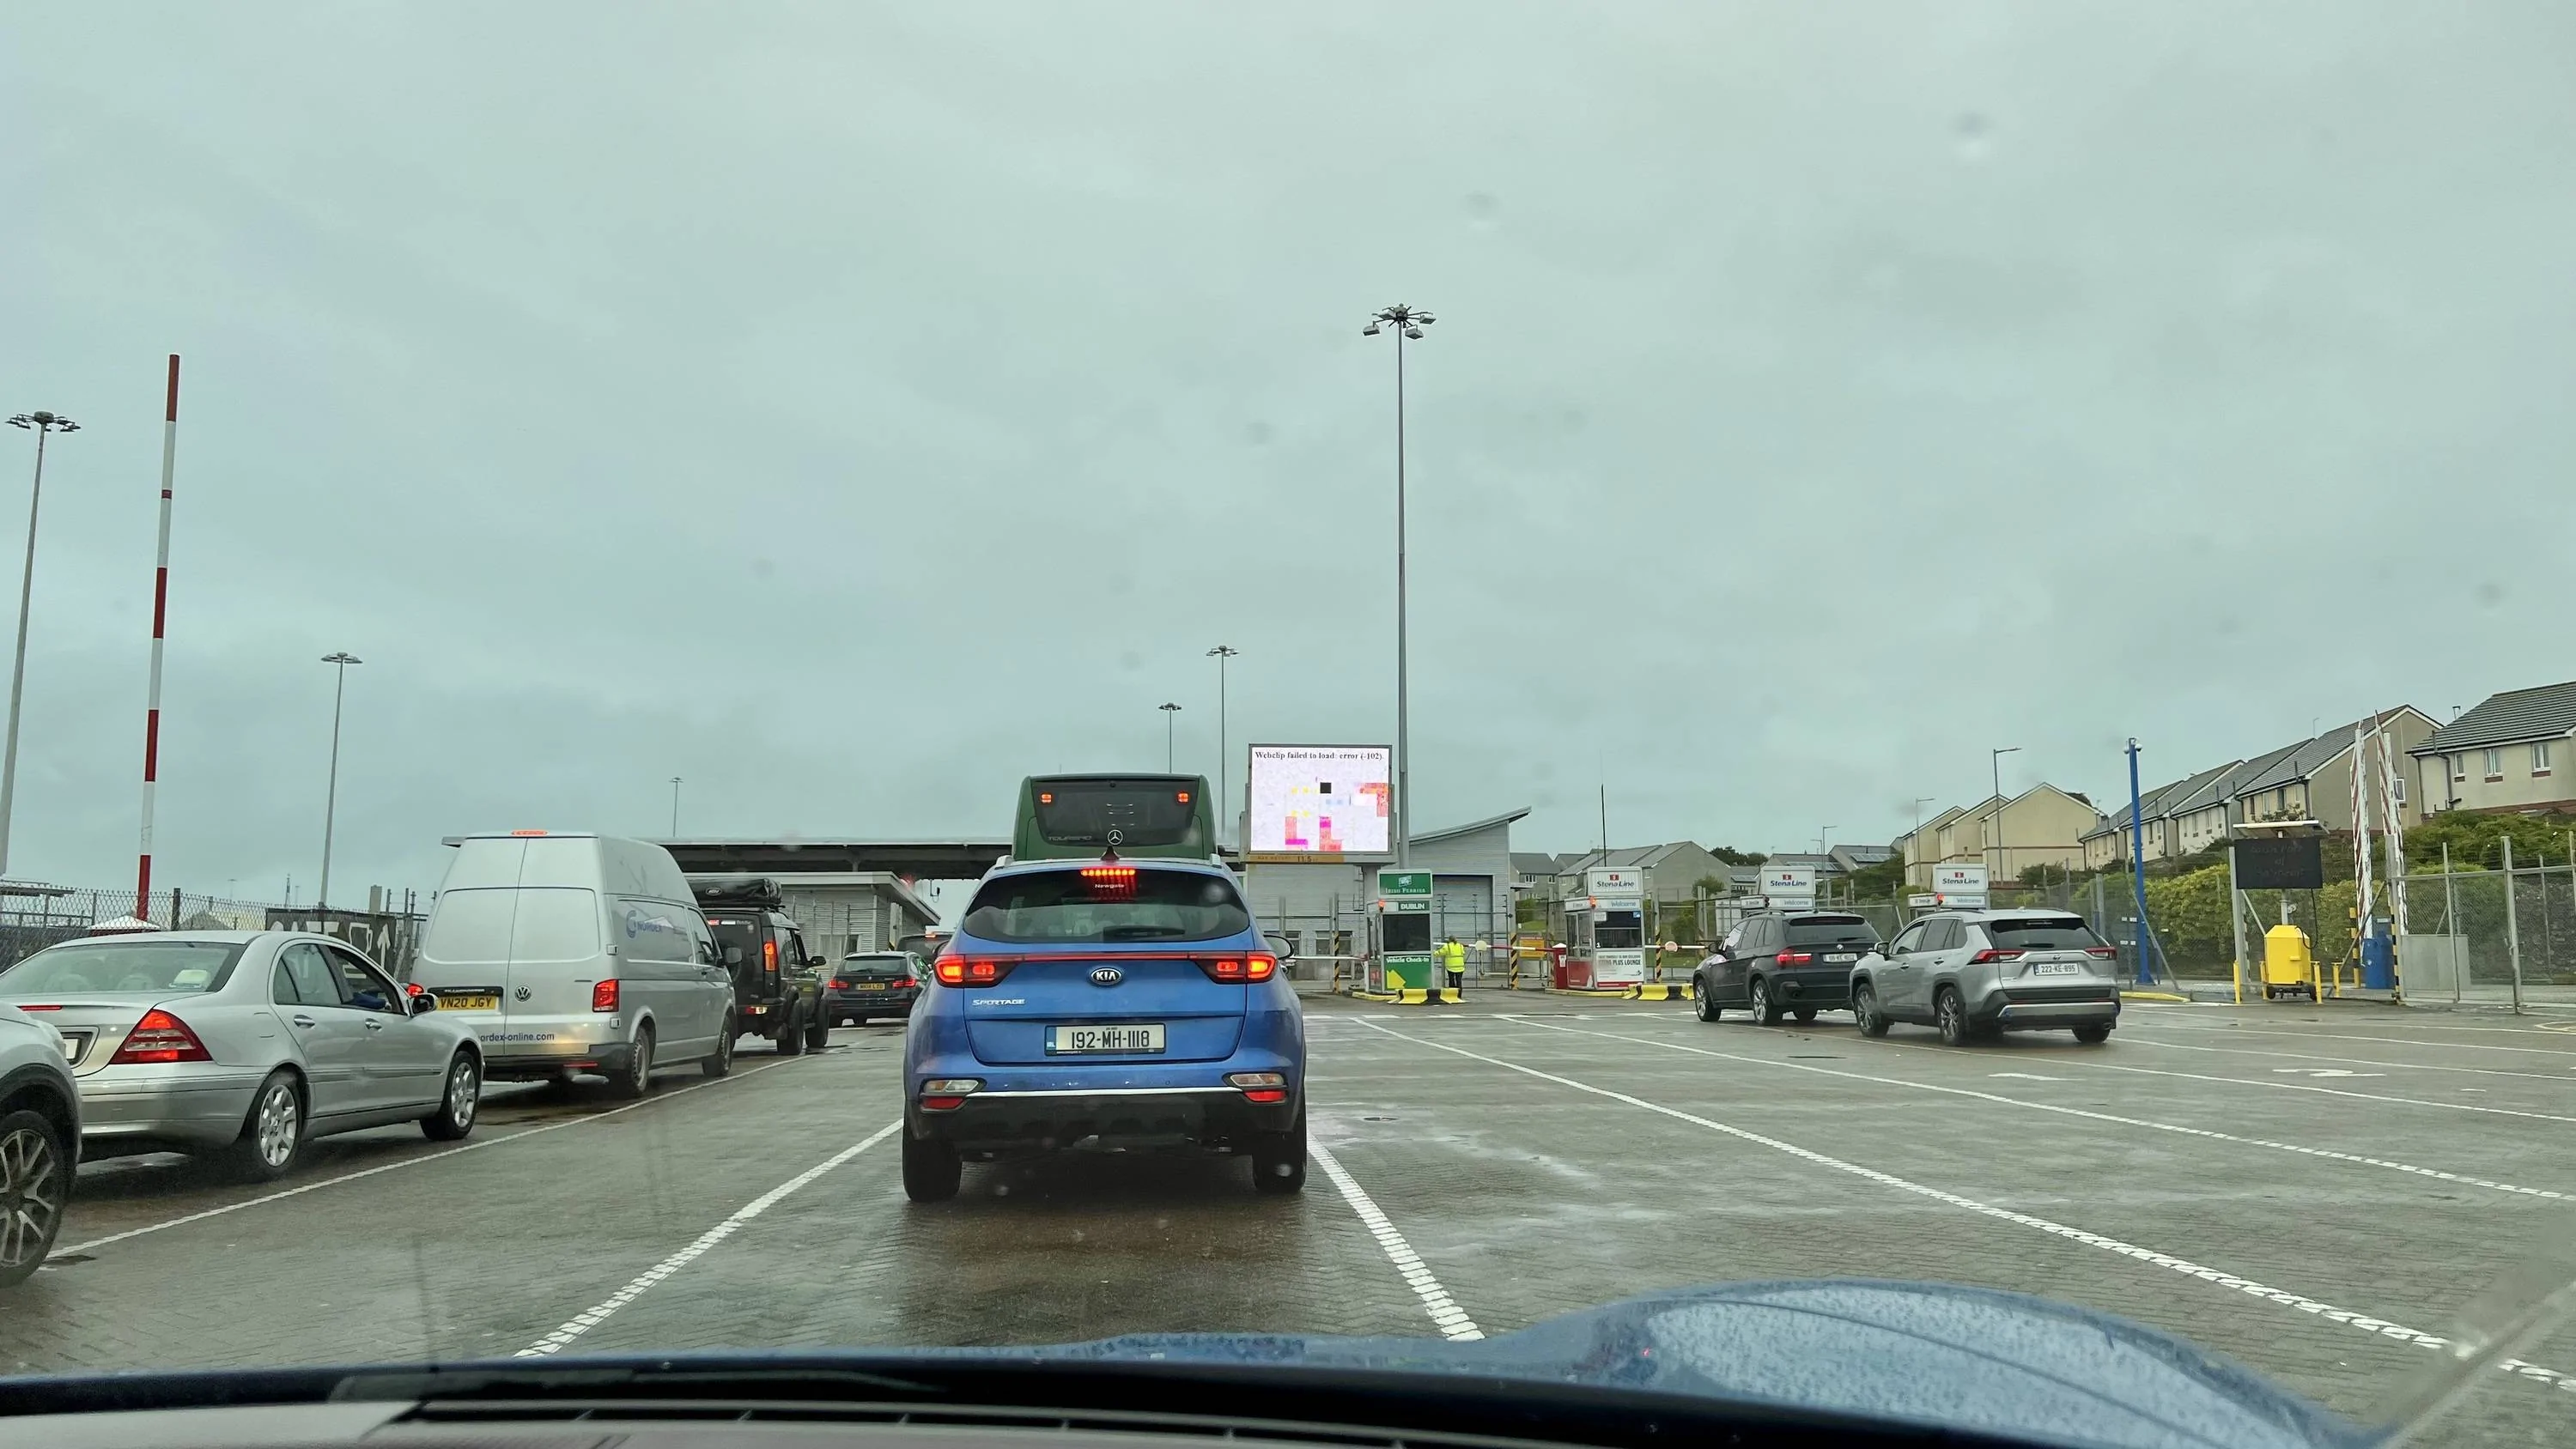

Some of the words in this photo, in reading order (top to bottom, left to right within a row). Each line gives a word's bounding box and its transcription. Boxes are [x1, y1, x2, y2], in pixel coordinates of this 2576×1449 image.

[1097, 971, 1116, 980] KIA
[440, 997, 468, 1009] VN20
[471, 997, 492, 1008] JGY
[479, 1032, 555, 1041] ordex-online.com
[1072, 1030, 1150, 1049] 192-MH-1118
